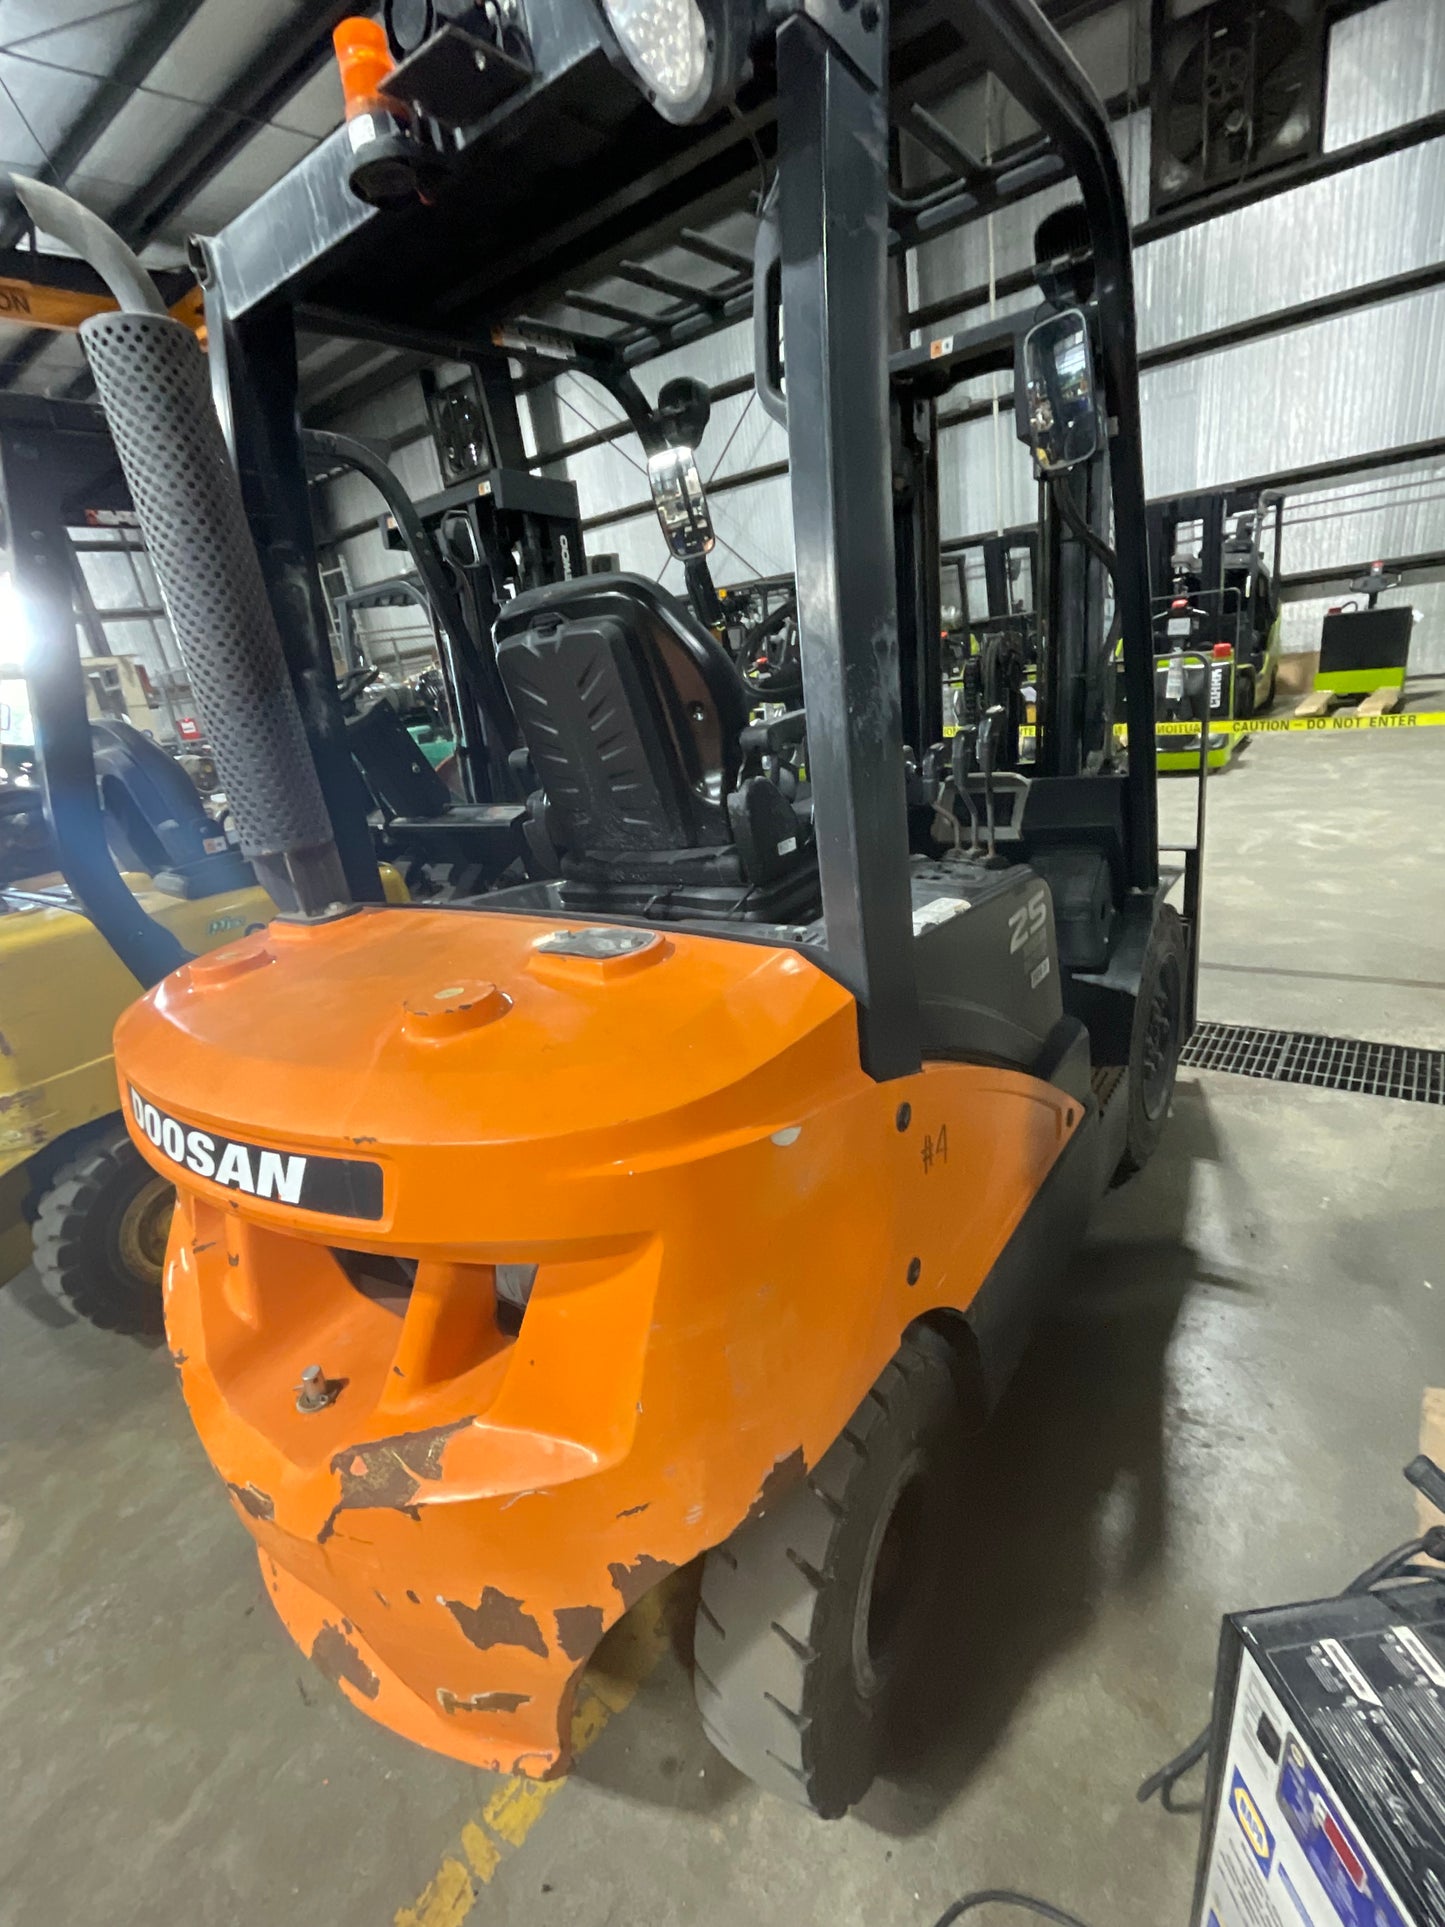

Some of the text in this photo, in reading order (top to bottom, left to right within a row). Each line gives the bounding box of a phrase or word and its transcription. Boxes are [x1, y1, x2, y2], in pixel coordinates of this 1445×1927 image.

[1210, 668, 1222, 708] CLARK
[1232, 721, 1290, 733] CAUTION
[1306, 719, 1326, 731] DO
[1332, 717, 1362, 729] NOT
[1369, 714, 1417, 728] ENTER
[130, 1086, 307, 1204] DOOSAN
[920, 1124, 947, 1175] #4
